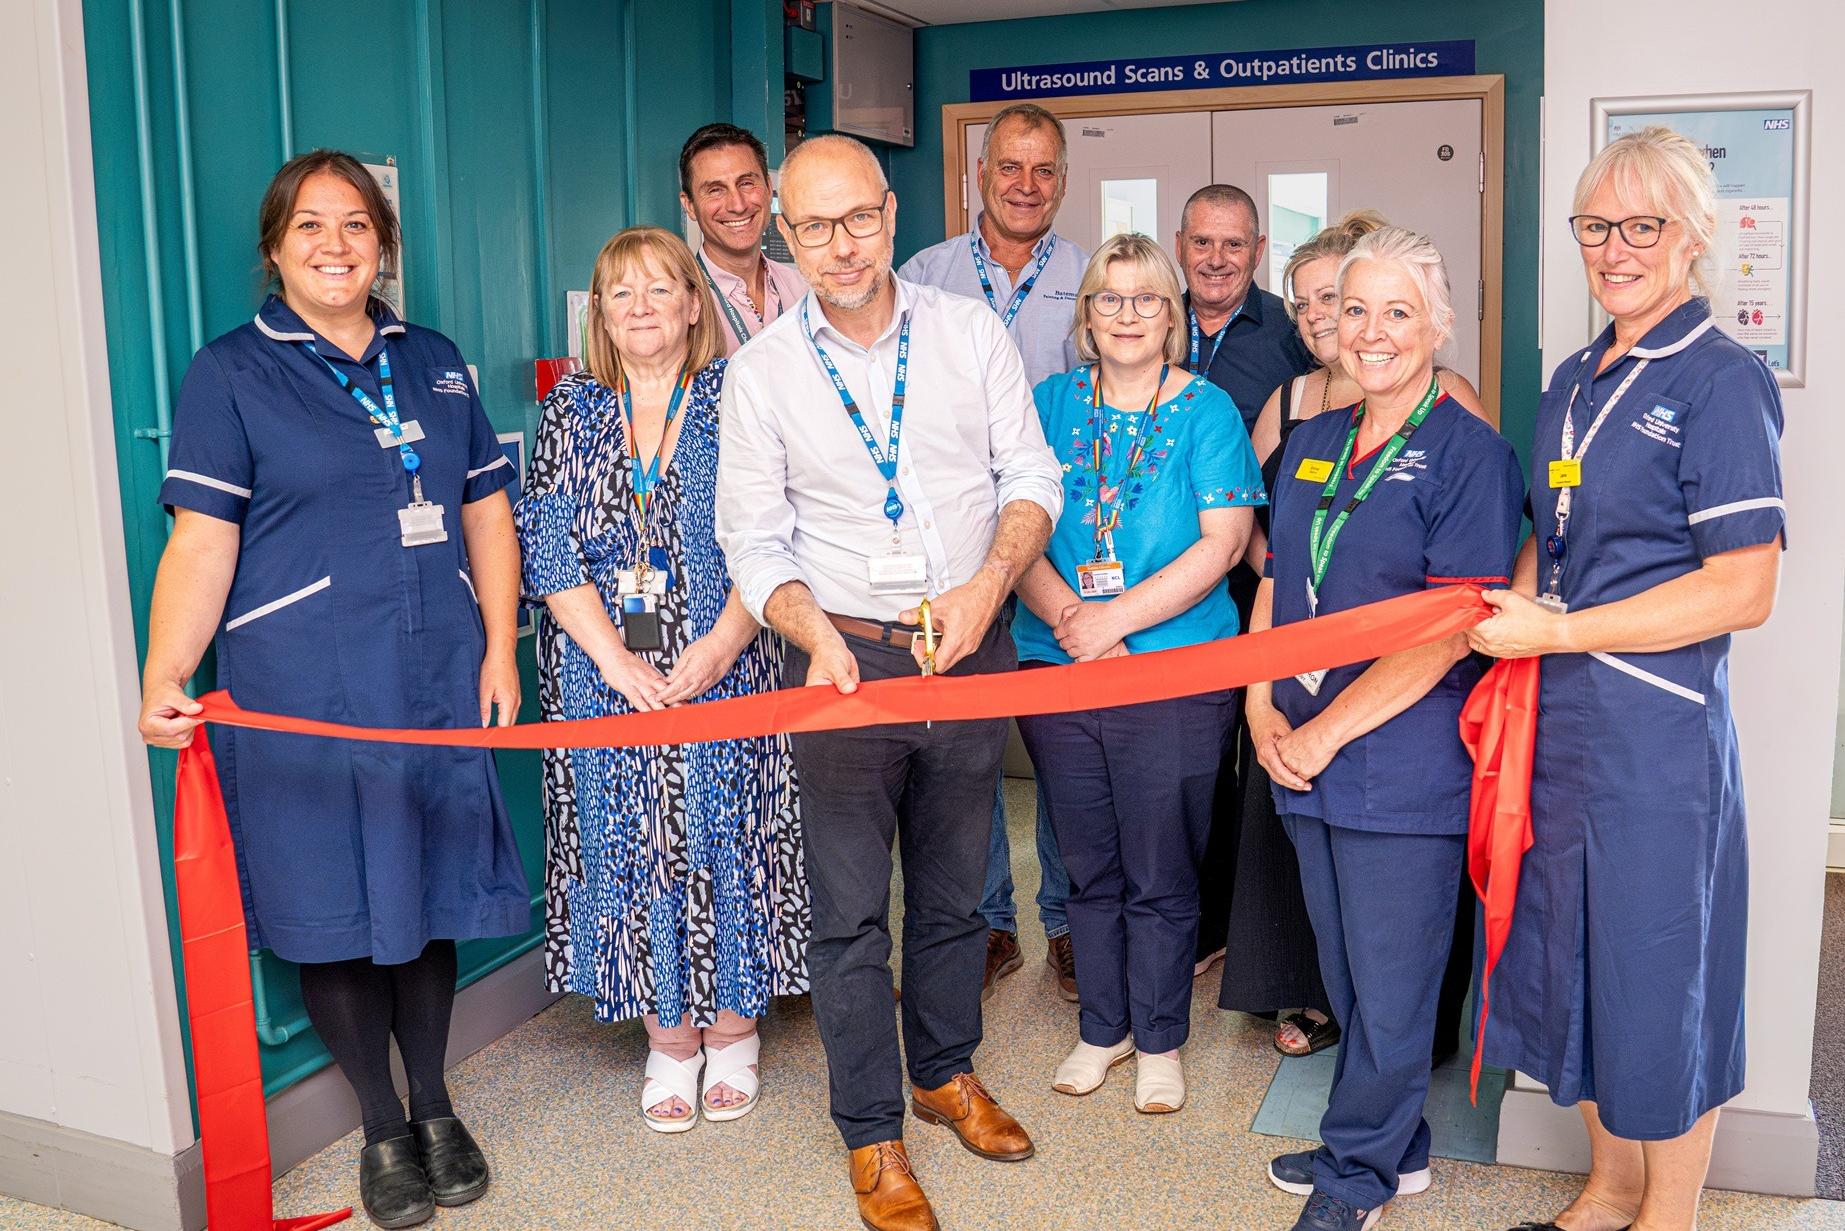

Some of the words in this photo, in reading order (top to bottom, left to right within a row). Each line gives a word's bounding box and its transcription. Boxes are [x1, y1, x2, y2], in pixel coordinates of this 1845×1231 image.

[1001, 65, 1116, 91] Ultrasound
[1124, 65, 1184, 83] Scans
[1193, 61, 1210, 79] &
[1219, 54, 1357, 80] Outpatients
[1366, 48, 1438, 70] Clinics
[1764, 119, 1788, 129] NHS
[1012, 298, 1021, 312] NHS
[900, 341, 908, 359] NHS
[821, 354, 835, 370] NHS
[446, 371, 464, 381] NHS
[897, 363, 906, 382] NHS
[832, 373, 846, 391] NHS
[360, 396, 377, 412] NHS
[385, 394, 395, 408] NHS
[376, 412, 393, 428] NHS
[389, 411, 399, 426] NHS
[1417, 407, 1425, 416] Up
[859, 425, 874, 442] NHS
[891, 421, 900, 439] NHS
[870, 446, 885, 464] NHS
[888, 443, 898, 462] NHS
[1381, 446, 1397, 466] Freedom
[1326, 525, 1339, 549] Freedom
